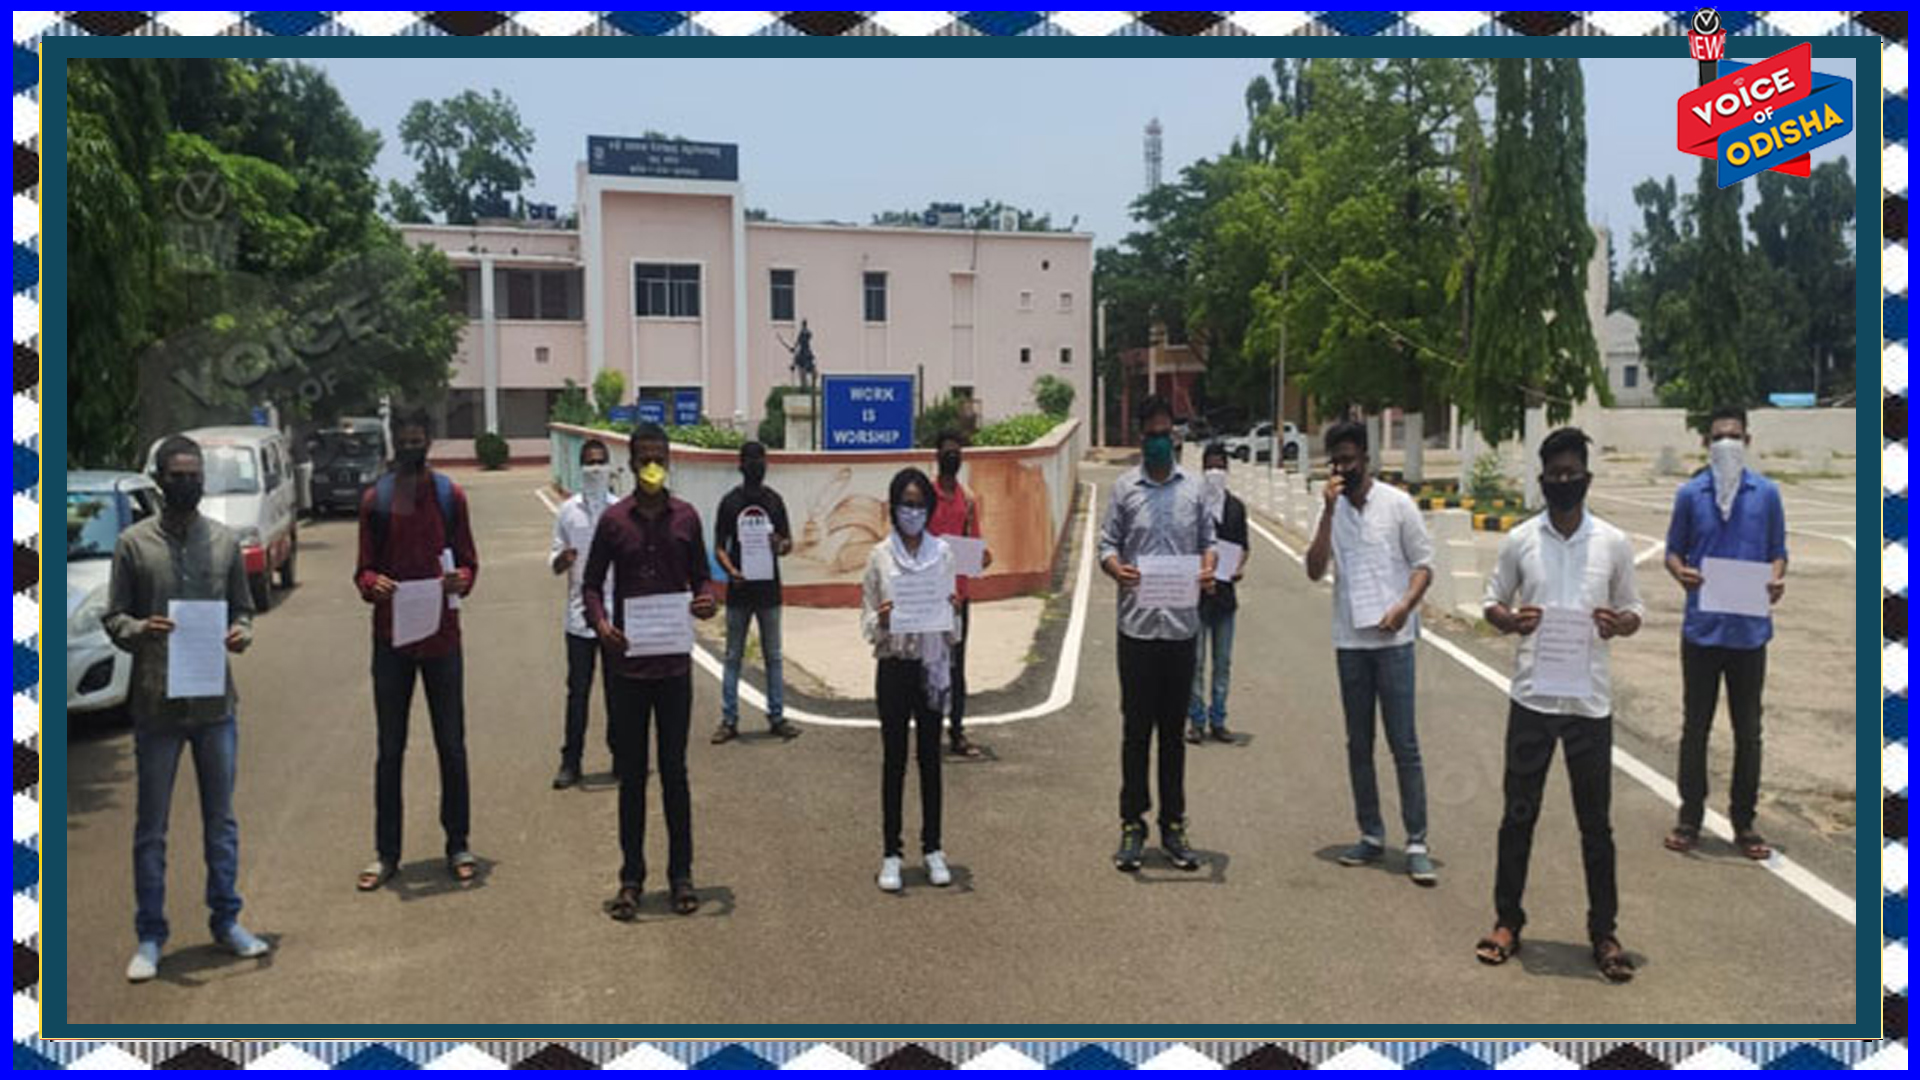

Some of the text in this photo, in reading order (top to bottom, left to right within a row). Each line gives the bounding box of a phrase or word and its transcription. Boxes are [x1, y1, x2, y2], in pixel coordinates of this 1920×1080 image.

[848, 386, 895, 402] WORK
[861, 407, 877, 423] IS
[832, 429, 901, 444] WORSHIP
